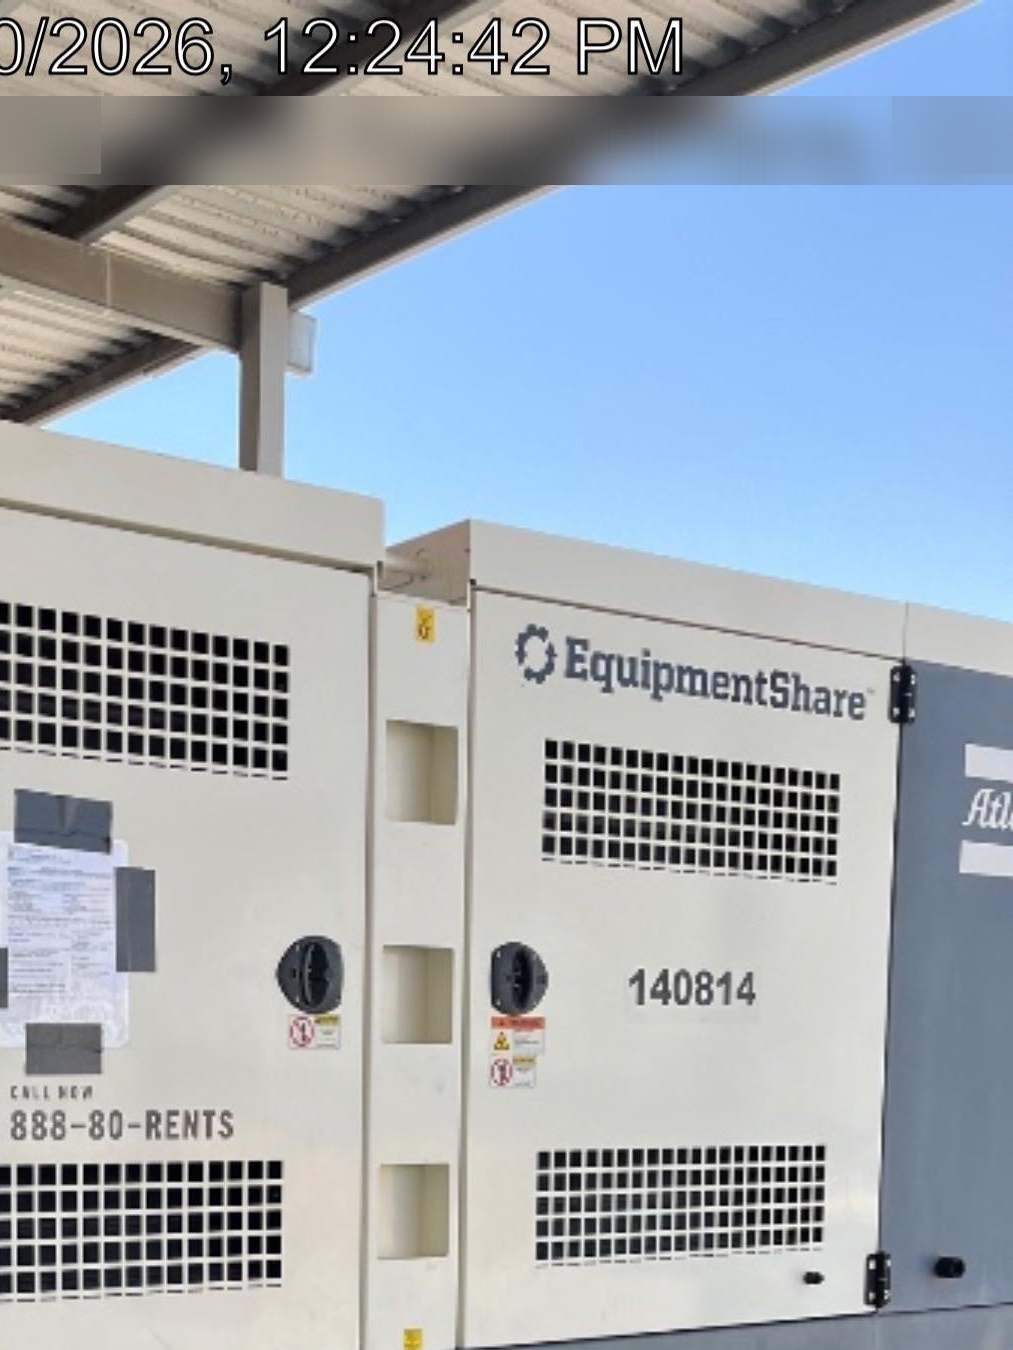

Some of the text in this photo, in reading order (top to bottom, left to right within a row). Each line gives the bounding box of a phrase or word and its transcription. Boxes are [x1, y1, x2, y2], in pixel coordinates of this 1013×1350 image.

[565, 636, 868, 721] EquipmentShare
[961, 787, 1013, 832] Atl
[628, 967, 757, 1006] 140814
[9, 1108, 235, 1141] 888-80-RENTS
